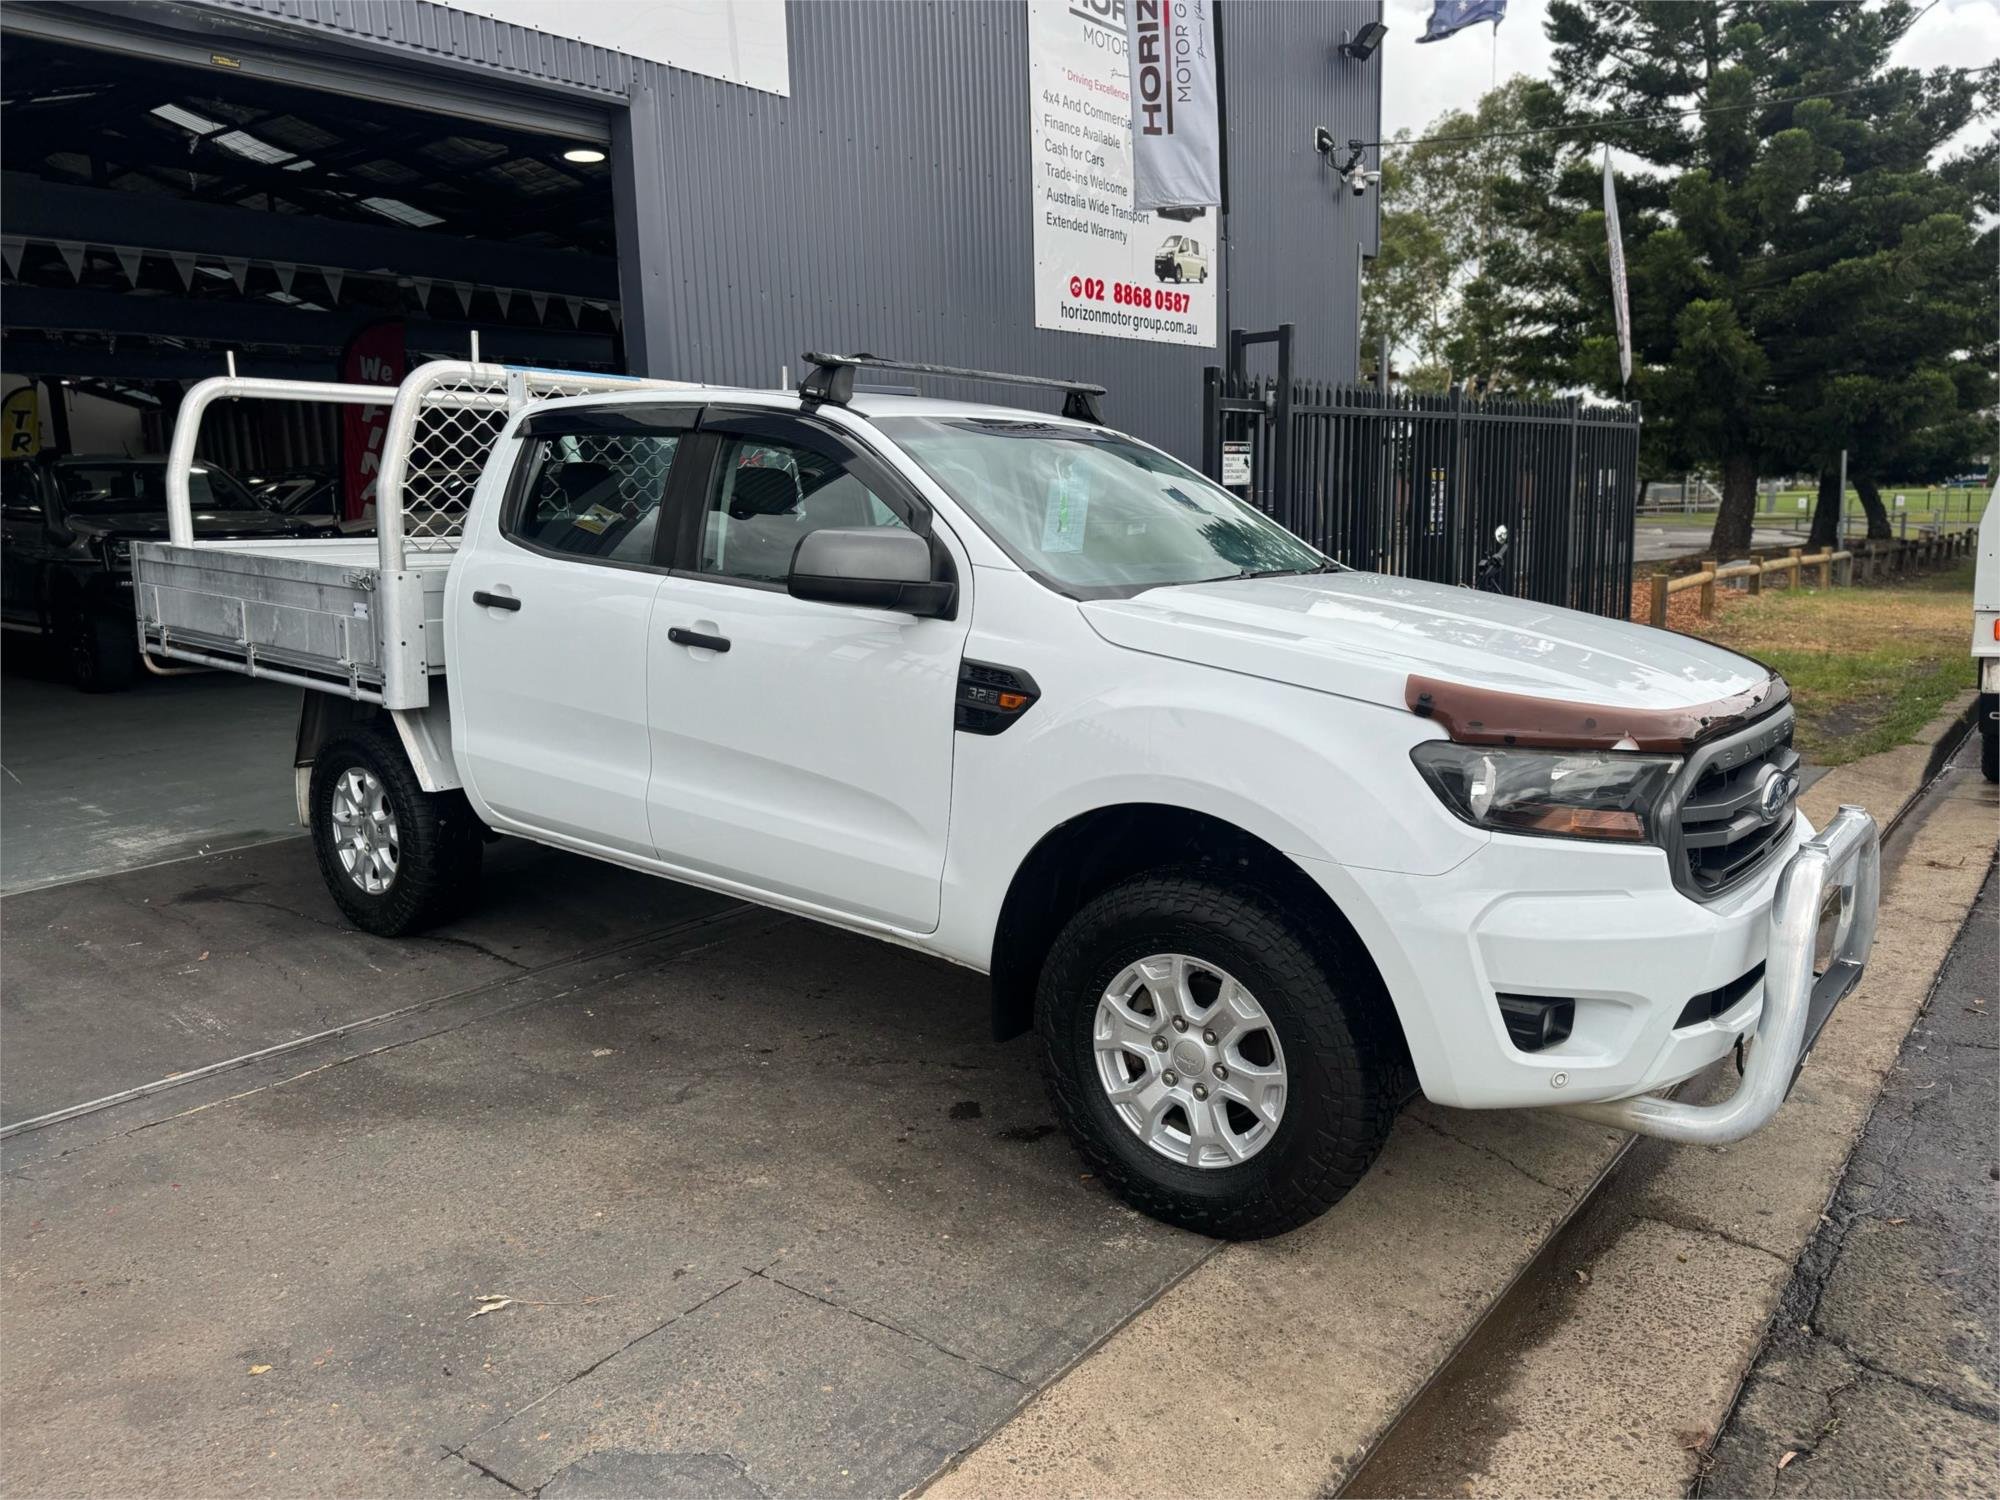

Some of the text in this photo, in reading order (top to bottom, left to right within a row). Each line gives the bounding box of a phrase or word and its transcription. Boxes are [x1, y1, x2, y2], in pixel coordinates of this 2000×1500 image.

[1174, 0, 1191, 102] MOTOR G
[1042, 89, 1133, 130] 4x4 And Commercia
[1044, 113, 1121, 149] Finance Available
[1044, 138, 1105, 167] Cash for Cars
[1045, 162, 1128, 197] Trade-ins Welcome
[1046, 187, 1149, 224] Australia Wide Transport
[1046, 211, 1128, 245] Extended Warranty
[1084, 277, 1190, 313] 02 8868 0587
[1060, 301, 1198, 335] horizonmotorgroup.com.au
[360, 355, 393, 382] We
[11, 409, 33, 456] TR
